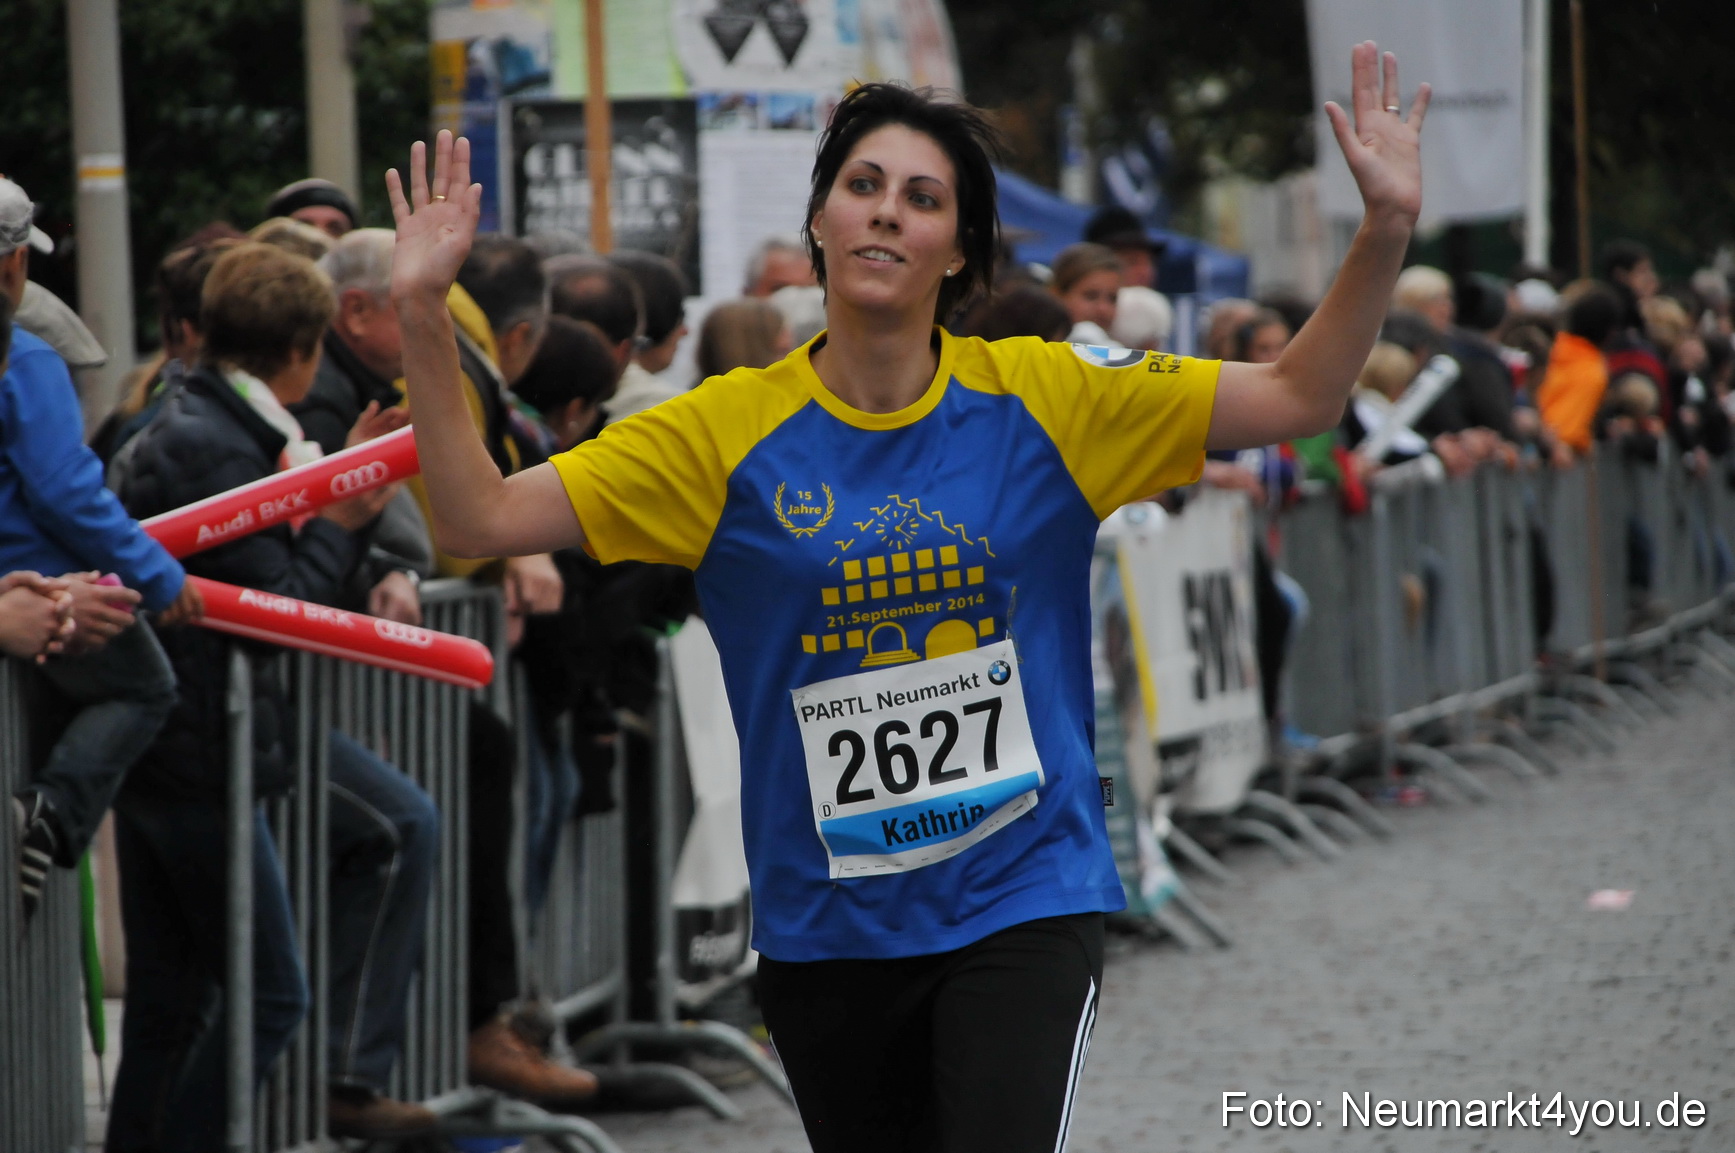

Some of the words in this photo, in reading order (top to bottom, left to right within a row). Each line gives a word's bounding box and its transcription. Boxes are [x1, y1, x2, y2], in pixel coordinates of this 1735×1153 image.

[787, 503, 822, 515] Jahre
[797, 490, 812, 500] 15
[196, 508, 254, 545] Audi
[259, 488, 310, 521] BKK
[239, 588, 299, 616] Audi
[303, 601, 355, 628] BKK
[947, 593, 985, 611] 2014
[800, 696, 872, 723] PARTL
[876, 672, 981, 710] Neumarkt
[827, 696, 1003, 806] 2627
[822, 804, 832, 817] D
